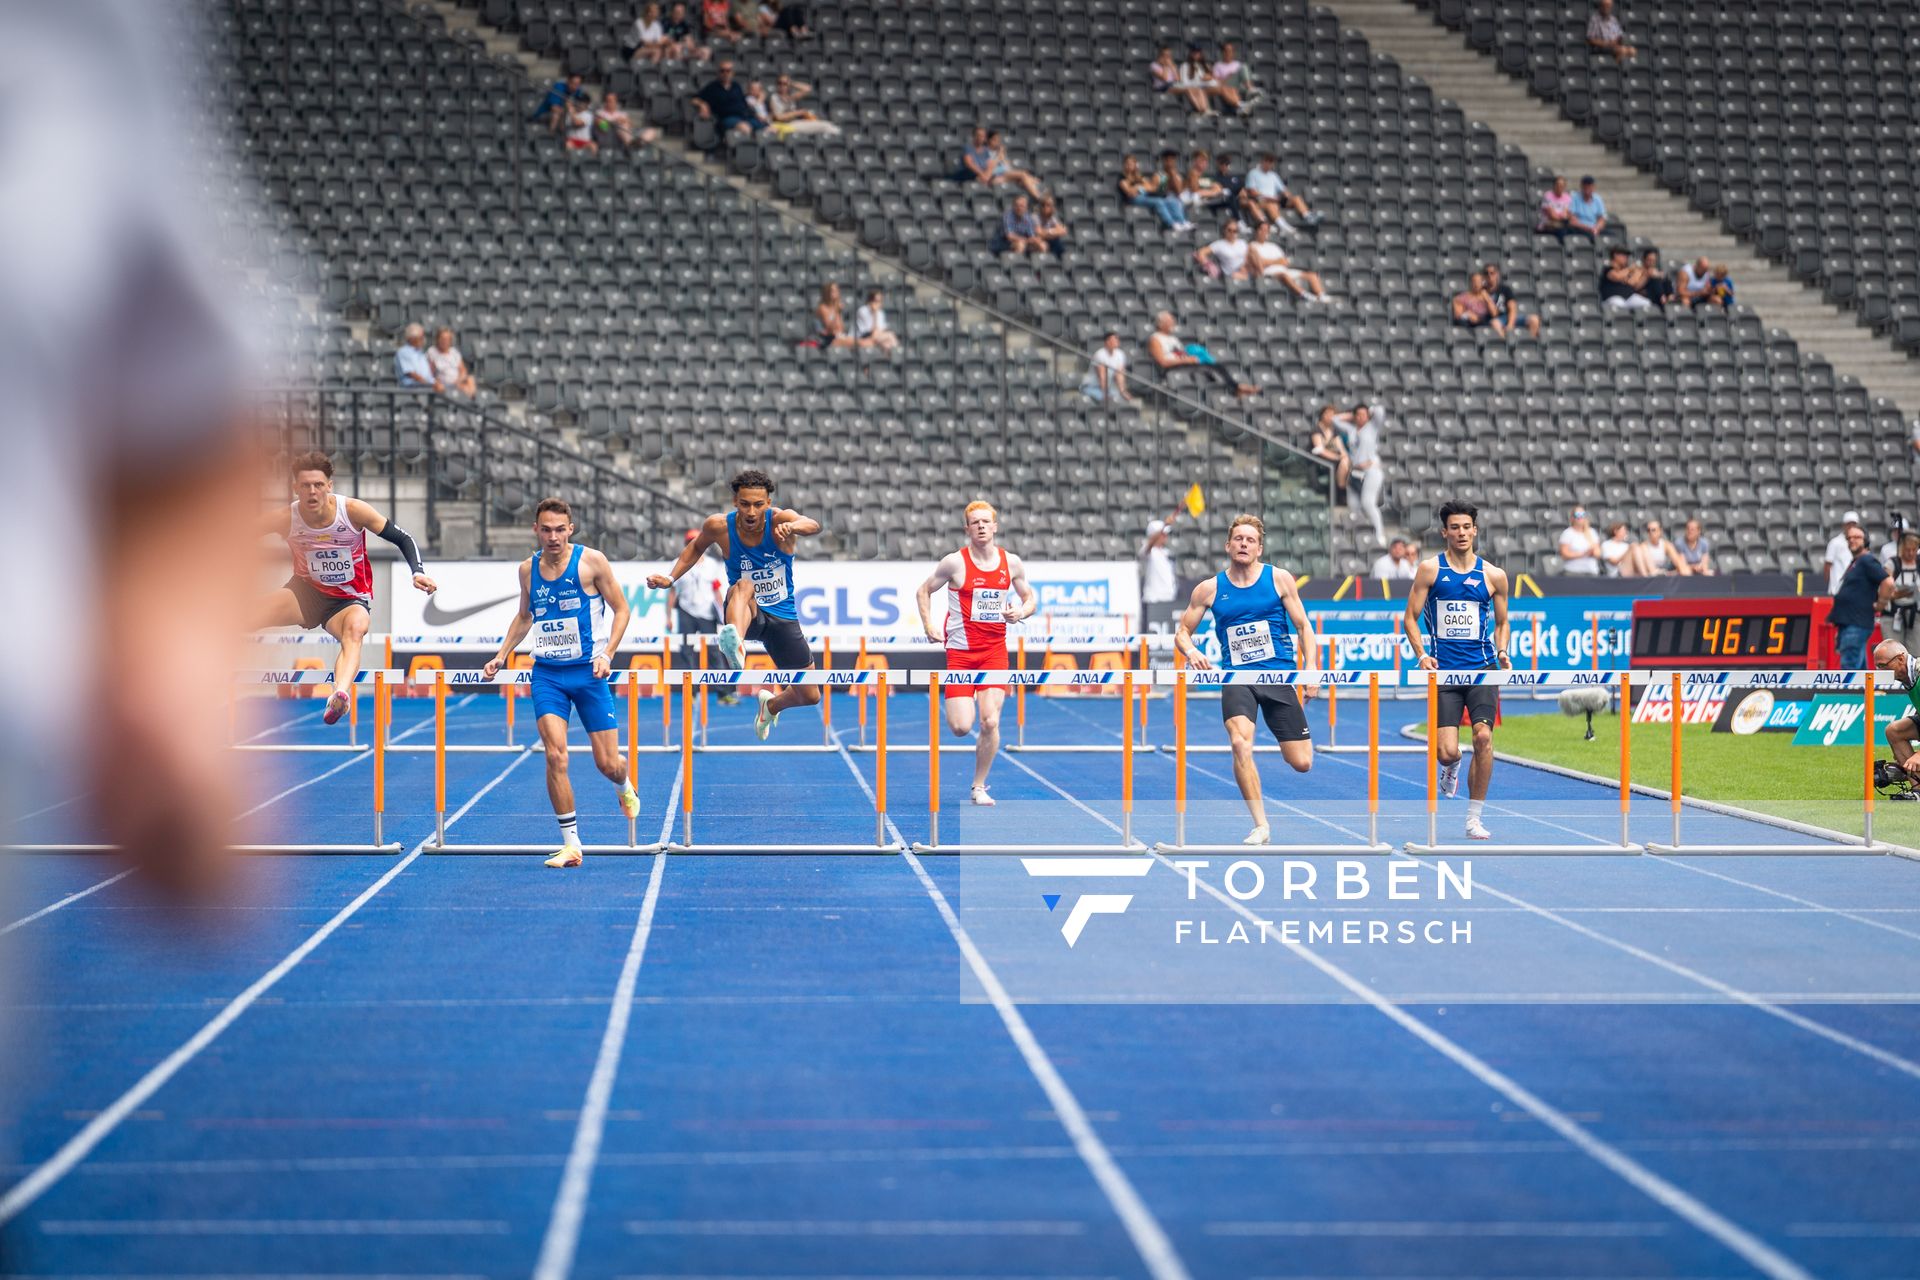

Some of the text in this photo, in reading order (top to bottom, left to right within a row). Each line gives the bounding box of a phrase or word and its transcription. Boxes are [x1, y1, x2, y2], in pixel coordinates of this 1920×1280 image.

[315, 550, 339, 559] GLS
[311, 560, 351, 572] L. ROOS
[751, 569, 774, 581] GLS
[753, 577, 783, 593] ORDON
[981, 590, 1000, 599] GLS
[1040, 584, 1106, 605] PLAN
[795, 586, 900, 627] GLS
[1446, 602, 1467, 612] GLS
[1443, 614, 1473, 626] GACIC
[541, 621, 565, 633] GLS
[1235, 624, 1257, 637] GLS
[535, 633, 579, 648] LEWANDOWSKI
[1230, 633, 1271, 652] SCHITTENHELM
[261, 672, 290, 684] ANA
[452, 672, 480, 684] ANA
[516, 672, 532, 684] AN
[699, 673, 727, 684] ANA
[762, 673, 791, 684] ANA
[826, 673, 855, 684] ANA
[944, 673, 972, 684] ANA
[1007, 673, 1035, 684] ANA
[1071, 673, 1099, 684] ANA
[1192, 673, 1220, 684] ANA
[1255, 673, 1284, 684] ANA
[1319, 673, 1347, 684] ANA
[1444, 673, 1472, 684] ANA
[1508, 673, 1536, 684] ANA
[1571, 673, 1598, 684] ANA
[1687, 673, 1716, 684] ANA
[1750, 673, 1778, 684] ANA
[1813, 673, 1841, 684] ANA
[1639, 701, 1697, 722] MOY
